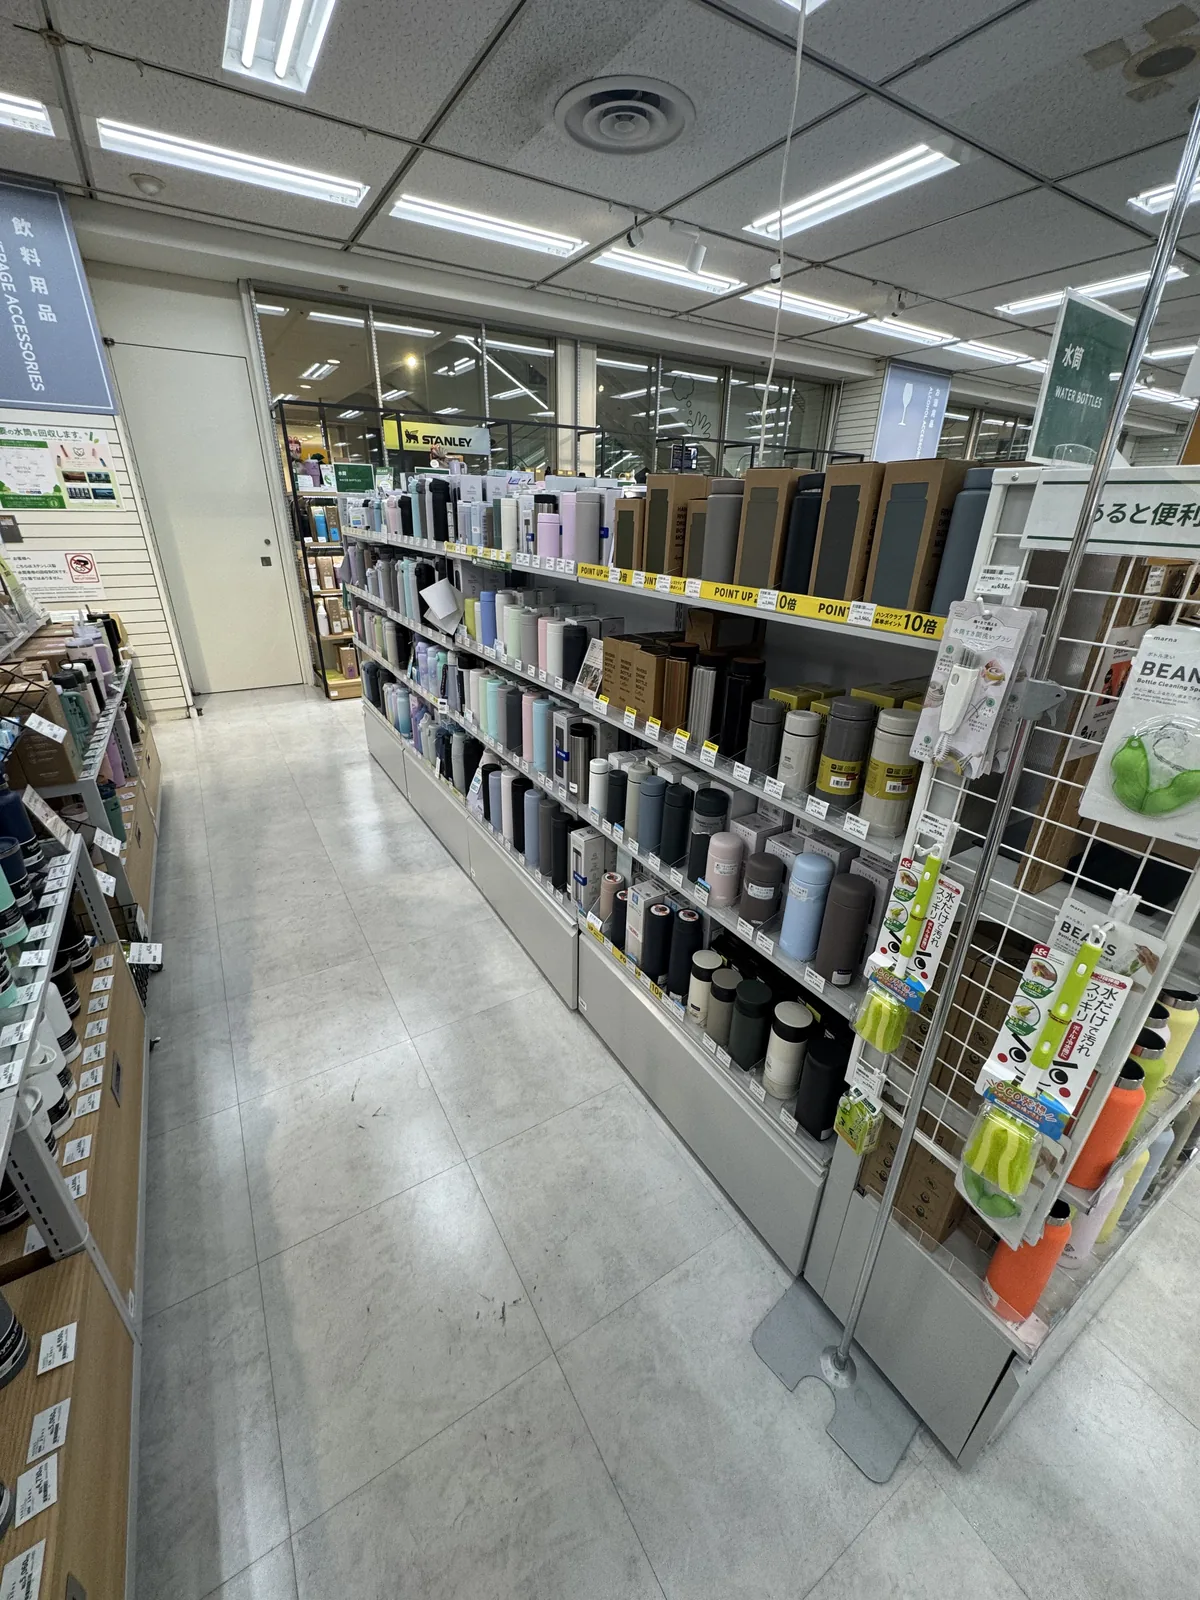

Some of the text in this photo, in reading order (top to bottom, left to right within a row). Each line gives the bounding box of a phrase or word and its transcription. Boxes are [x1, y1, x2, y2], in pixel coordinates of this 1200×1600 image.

[11, 216, 58, 323] 飲料用品
[4, 293, 45, 392] ACCESSORIES
[1062, 342, 1085, 372] 水筒
[1054, 384, 1103, 409] WATER BOTTLES
[422, 434, 472, 448] STANLEY
[580, 566, 596, 576] POINT
[596, 569, 603, 577] UP
[714, 587, 739, 600] POINT
[741, 590, 753, 602] UP
[903, 613, 938, 635] 10倍
[1153, 635, 1178, 643] marna
[1136, 677, 1157, 686] Bottle
[1157, 681, 1188, 692] Cleaning
[1034, 948, 1048, 956] LEC
[1076, 981, 1101, 1022] スッキリ
[1076, 987, 1119, 1058] 水だけで汚れ
